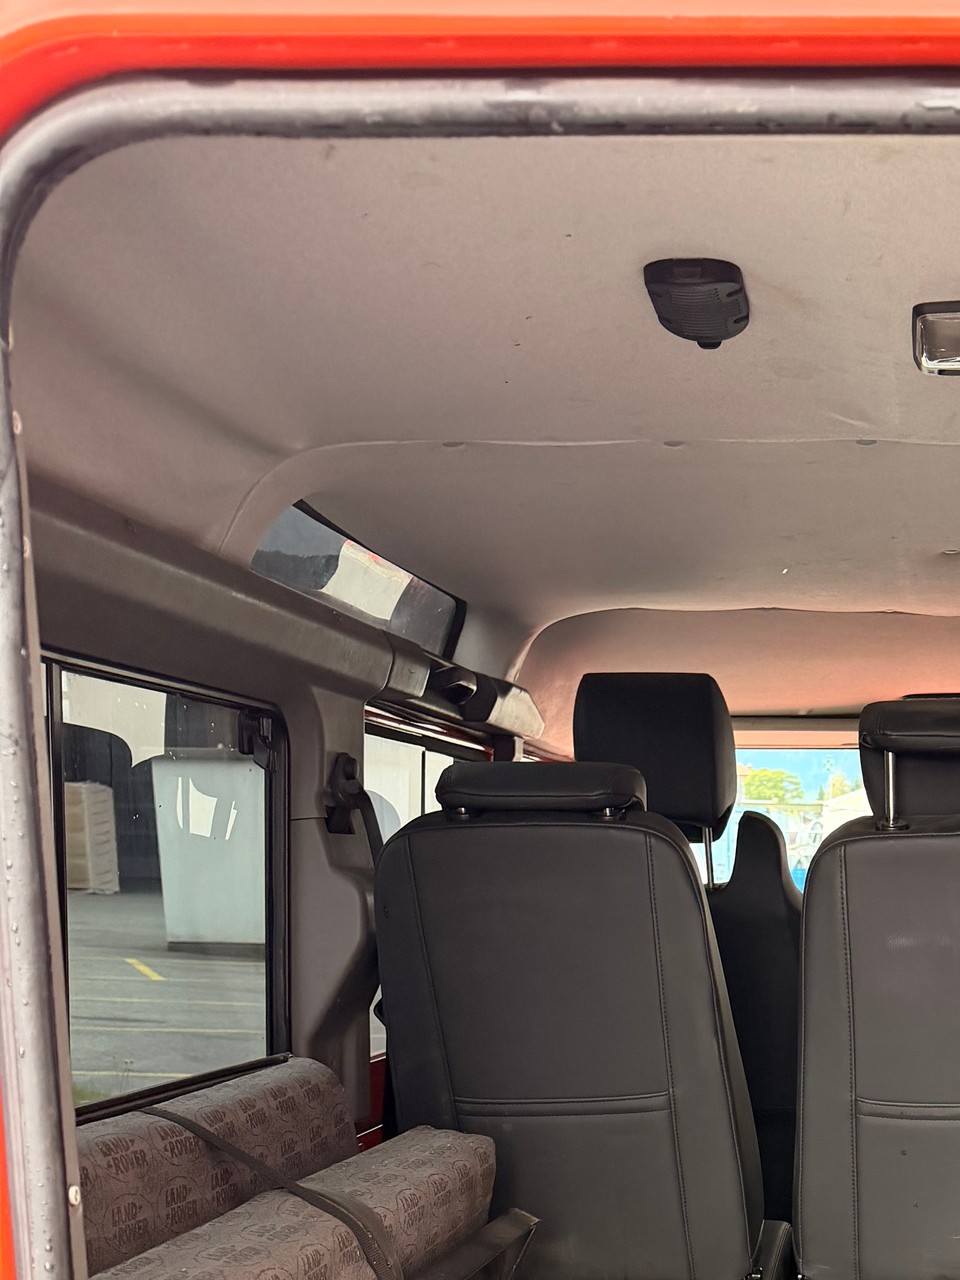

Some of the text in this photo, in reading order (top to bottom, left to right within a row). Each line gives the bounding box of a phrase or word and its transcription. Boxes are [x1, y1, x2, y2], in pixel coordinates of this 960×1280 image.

[155, 1125, 184, 1141] LAND
[95, 1137, 130, 1157] LAND
[168, 1136, 200, 1159] ROVER
[112, 1150, 149, 1175] ROVER
[211, 1168, 230, 1190] LAND
[165, 1185, 188, 1207] LAND
[112, 1202, 138, 1227] LAND
[171, 1199, 198, 1227] ROVER
